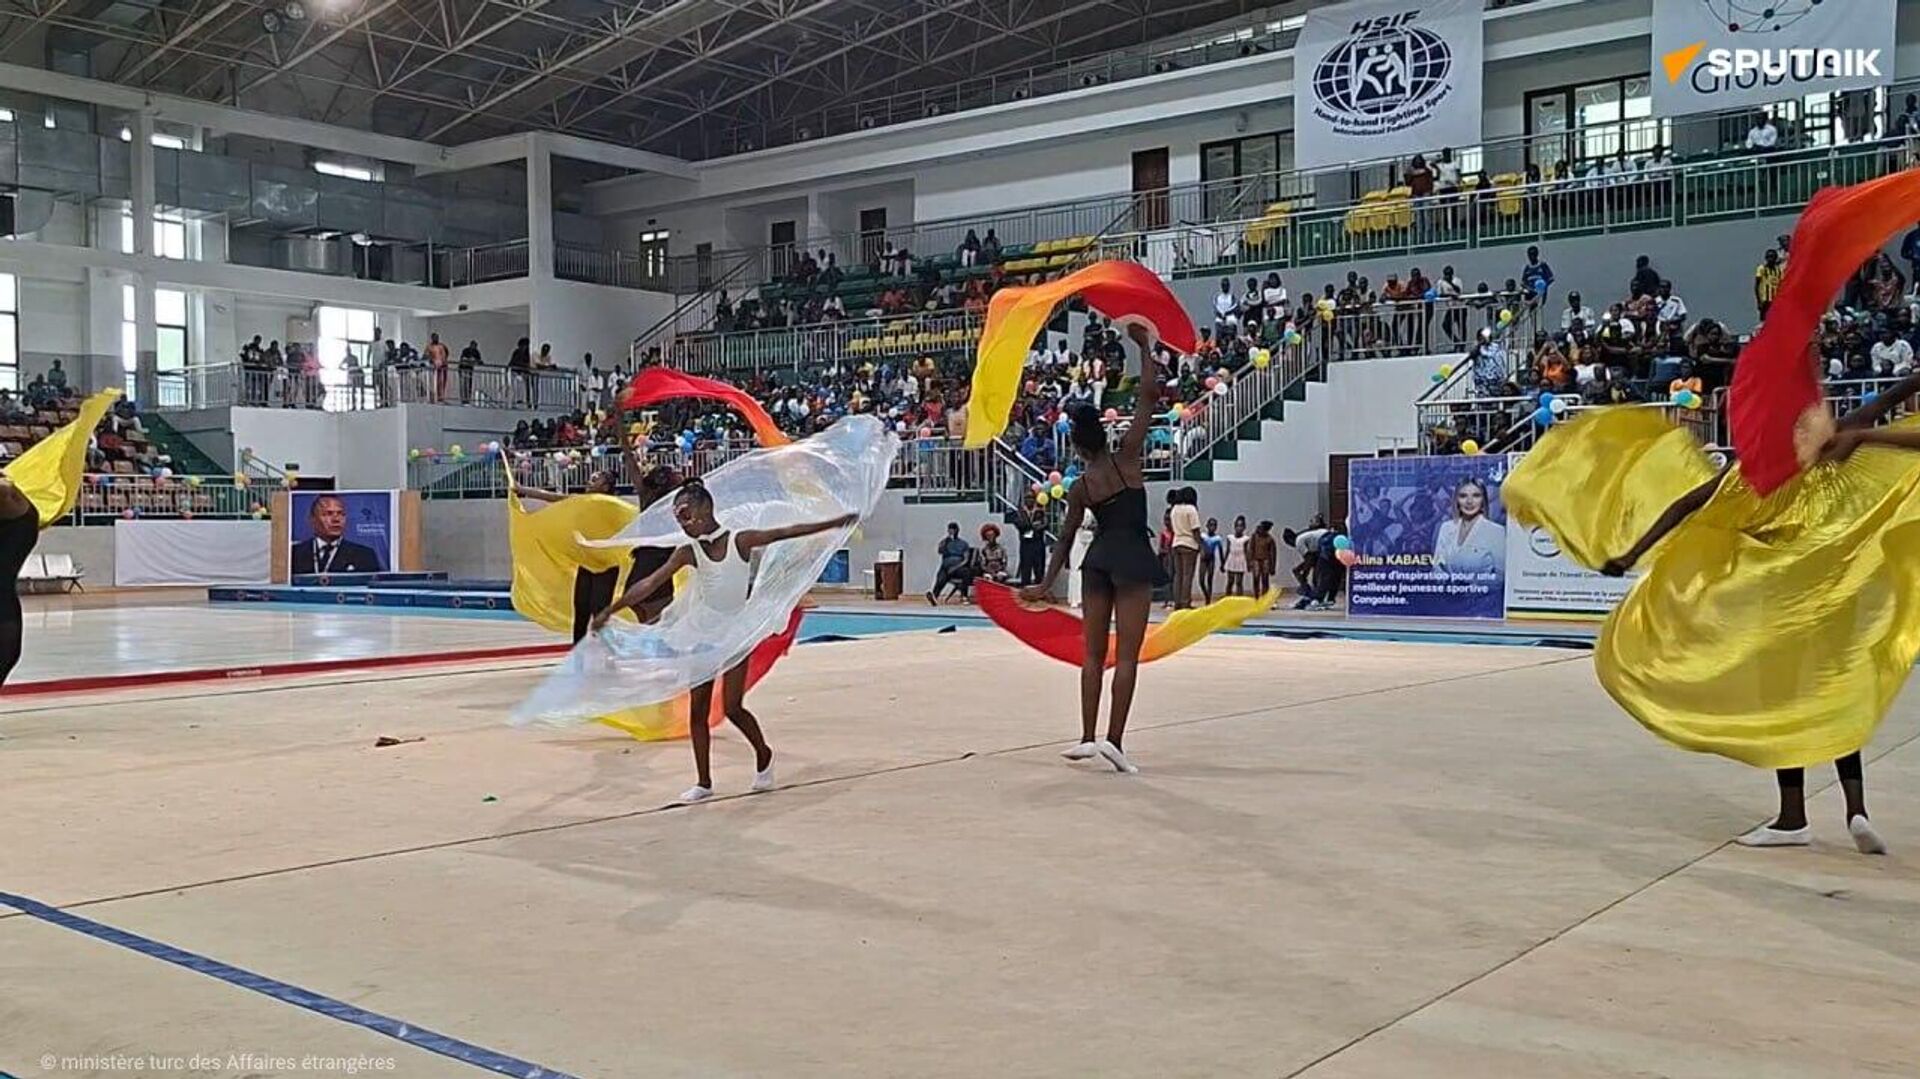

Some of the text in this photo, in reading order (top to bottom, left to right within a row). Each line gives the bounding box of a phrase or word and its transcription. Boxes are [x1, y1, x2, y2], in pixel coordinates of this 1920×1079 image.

[1351, 10, 1420, 34] HSIF
[1380, 105, 1425, 125] Fighting
[1333, 114, 1432, 136] International Federation
[1354, 554, 1447, 566] Alina KABAEVA
[1353, 570, 1497, 582] Source d'inspiration pour une
[1353, 583, 1489, 595] meilleure jeunesse sportive
[1352, 595, 1410, 606] Congolaise.
